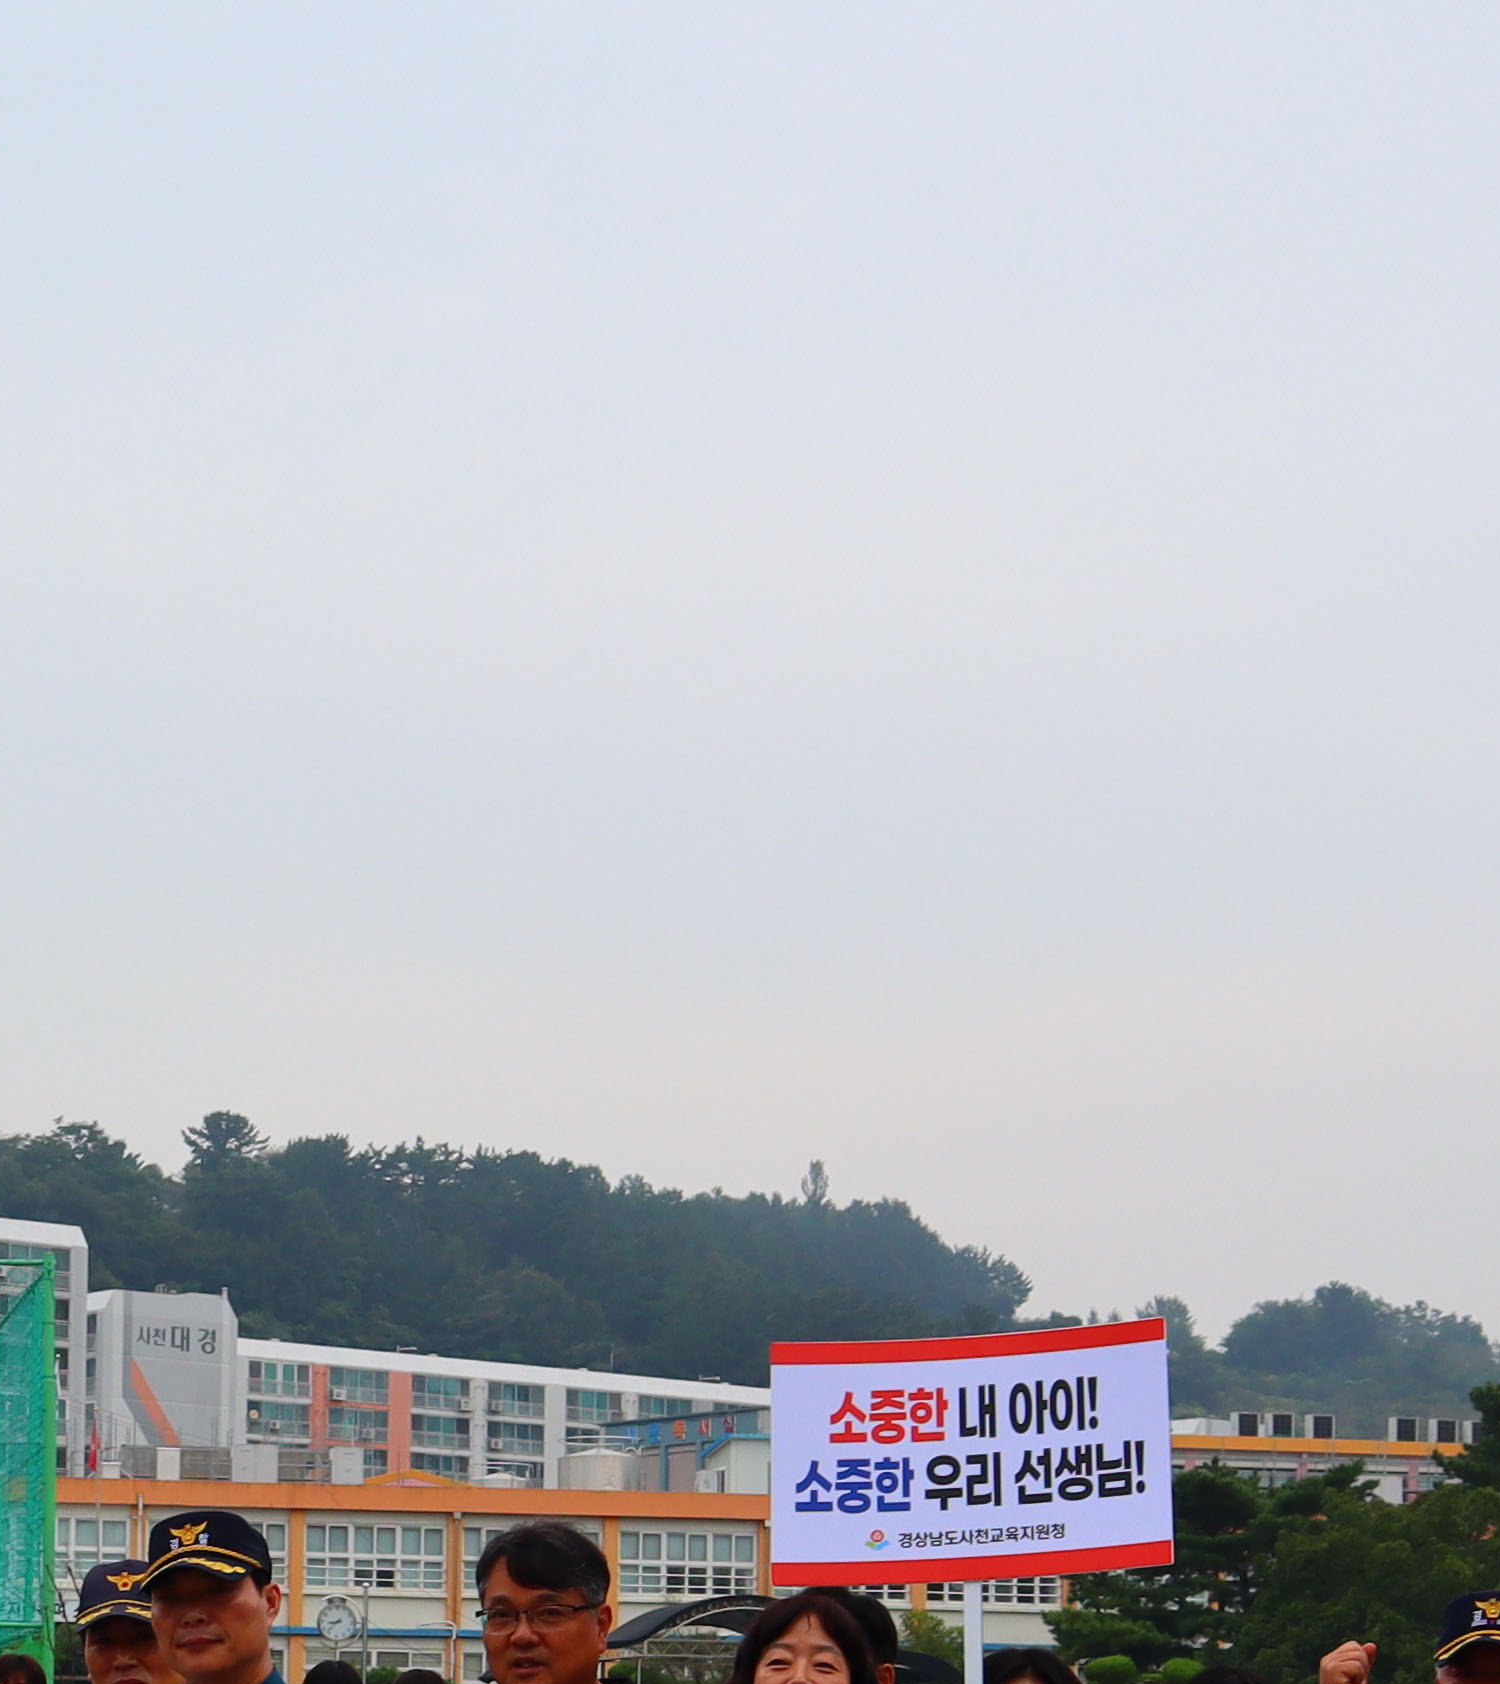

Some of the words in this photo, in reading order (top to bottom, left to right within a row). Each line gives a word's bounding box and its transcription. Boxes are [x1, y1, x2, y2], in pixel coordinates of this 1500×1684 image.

[829, 1386, 948, 1444] 소중한
[959, 1383, 997, 1438] 내
[1009, 1375, 1099, 1435] 아이!
[794, 1455, 915, 1514] 소중한
[924, 1451, 1002, 1511] 우리
[1014, 1440, 1146, 1505] 선생님!
[898, 1523, 1066, 1549] 경상남도사천교육지원청
